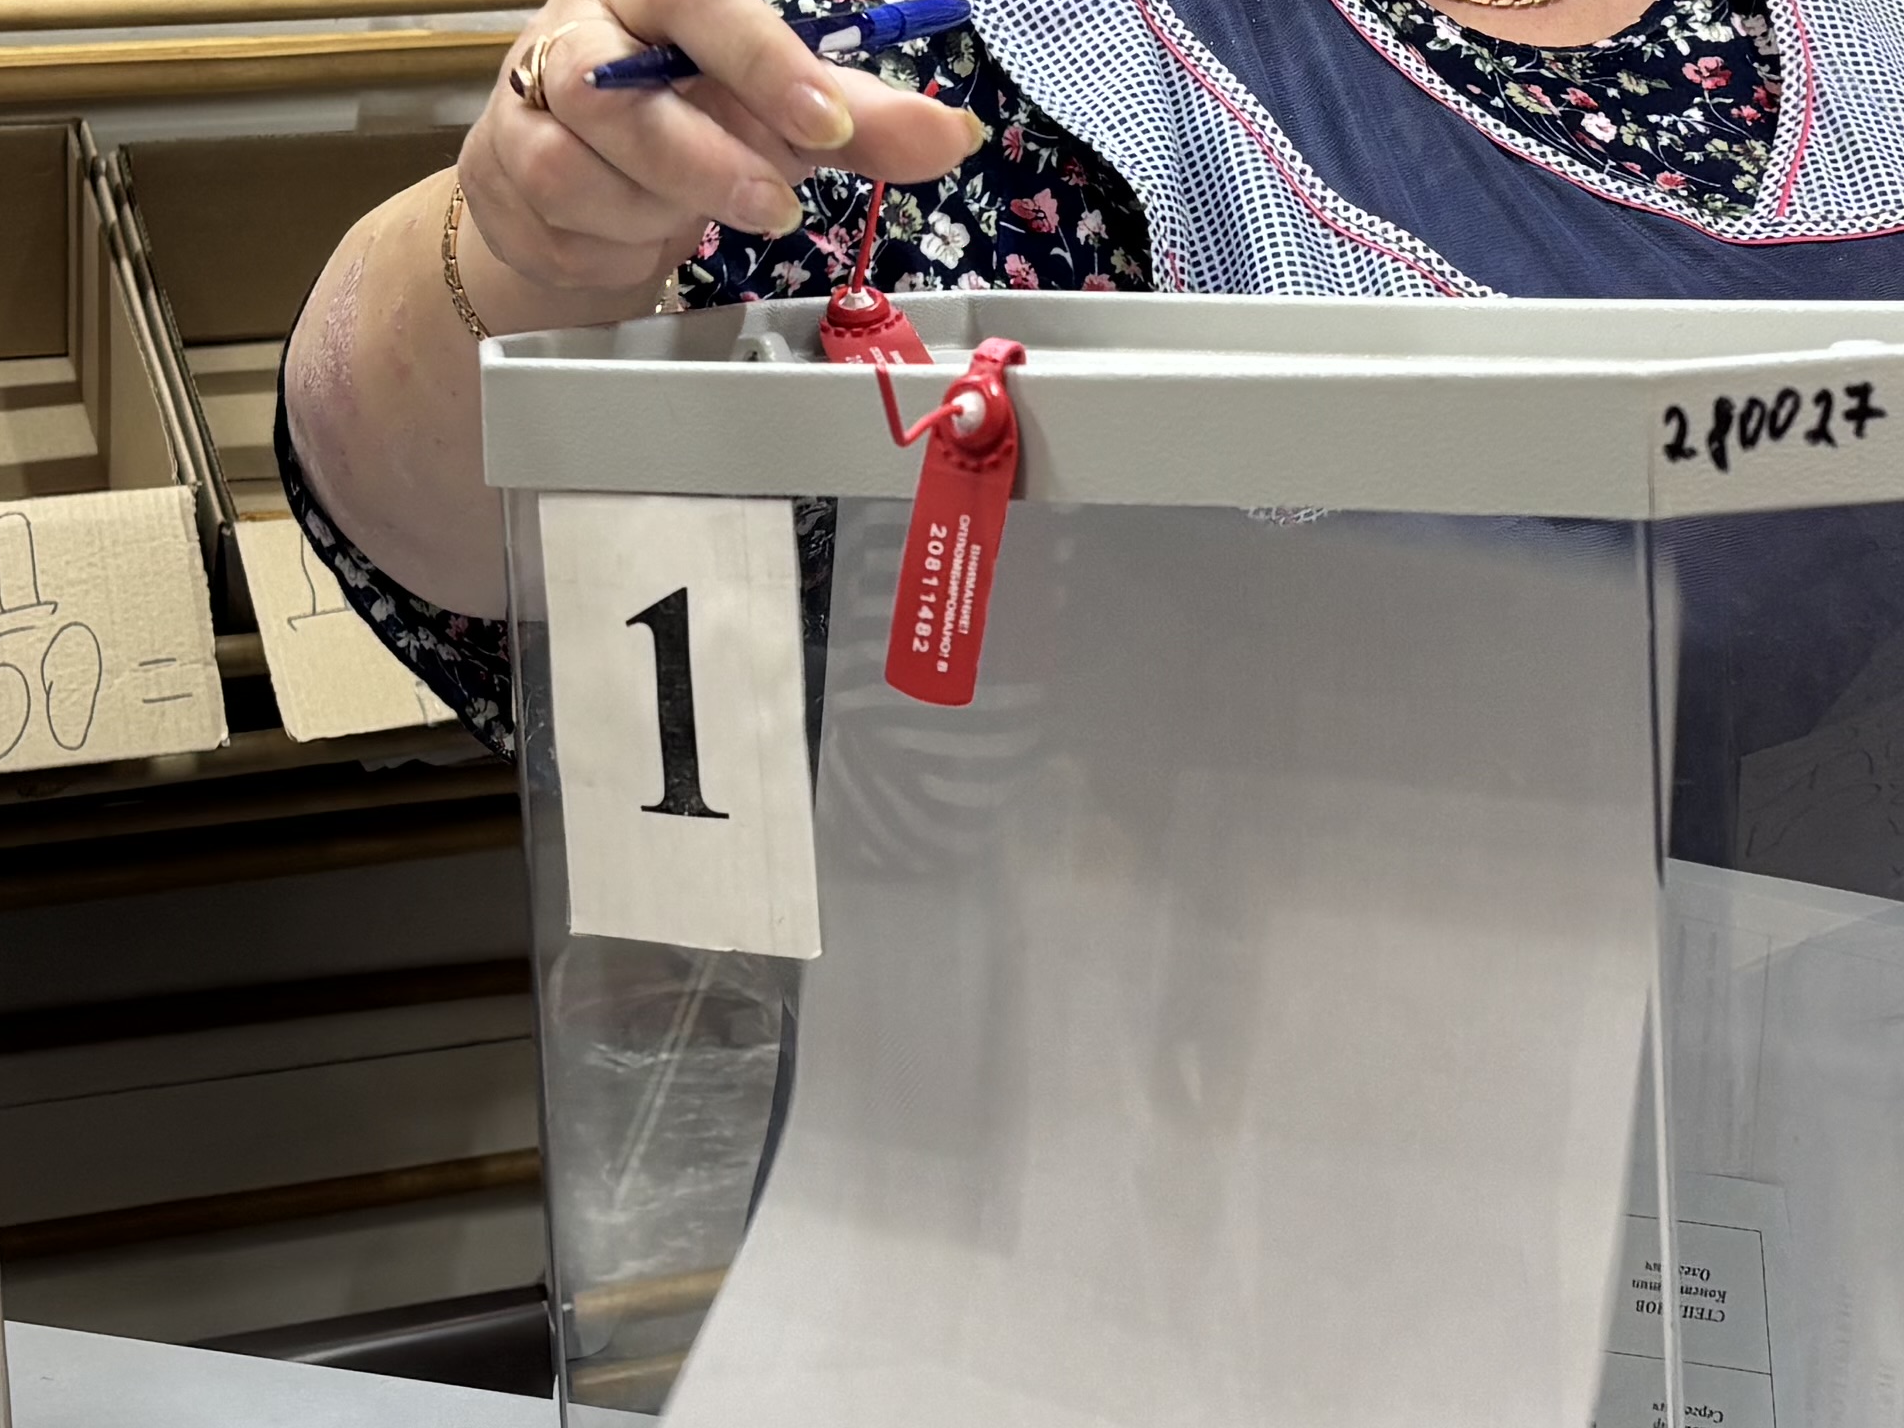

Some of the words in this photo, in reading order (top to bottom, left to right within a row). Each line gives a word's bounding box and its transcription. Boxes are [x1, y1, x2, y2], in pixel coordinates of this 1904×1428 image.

[1661, 381, 1886, 472] 280027
[912, 523, 948, 653] 20811482
[624, 586, 730, 819] 1
